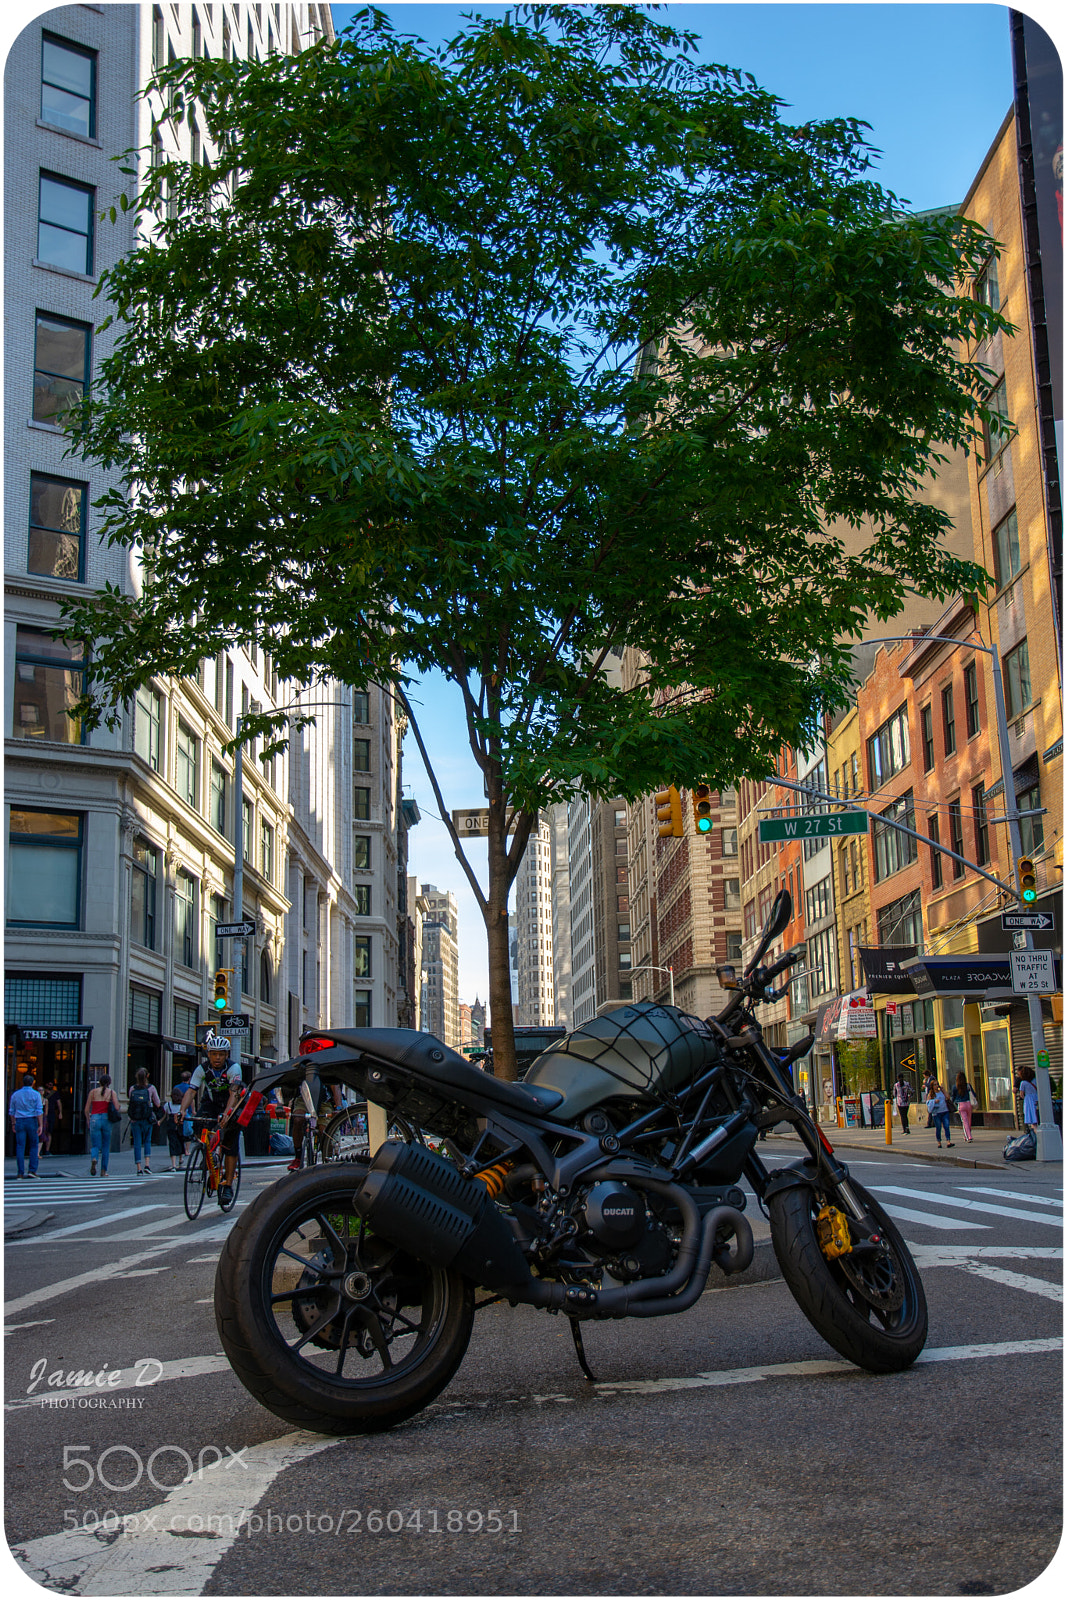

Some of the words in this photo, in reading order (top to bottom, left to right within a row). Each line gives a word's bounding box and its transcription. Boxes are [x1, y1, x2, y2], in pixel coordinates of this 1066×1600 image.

[465, 817, 489, 829] ONE
[784, 821, 797, 836] W
[804, 819, 820, 834] 27
[828, 817, 843, 832] St
[220, 926, 232, 934] ONE
[237, 925, 250, 933] WAY
[1015, 955, 1026, 963] NO
[1016, 963, 1048, 972] TRAFFIC
[1028, 972, 1038, 980] AT
[1041, 980, 1049, 988] St
[23, 1030, 48, 1039] THE
[51, 1030, 89, 1040] SMITH
[603, 1208, 634, 1216] DUCATI
